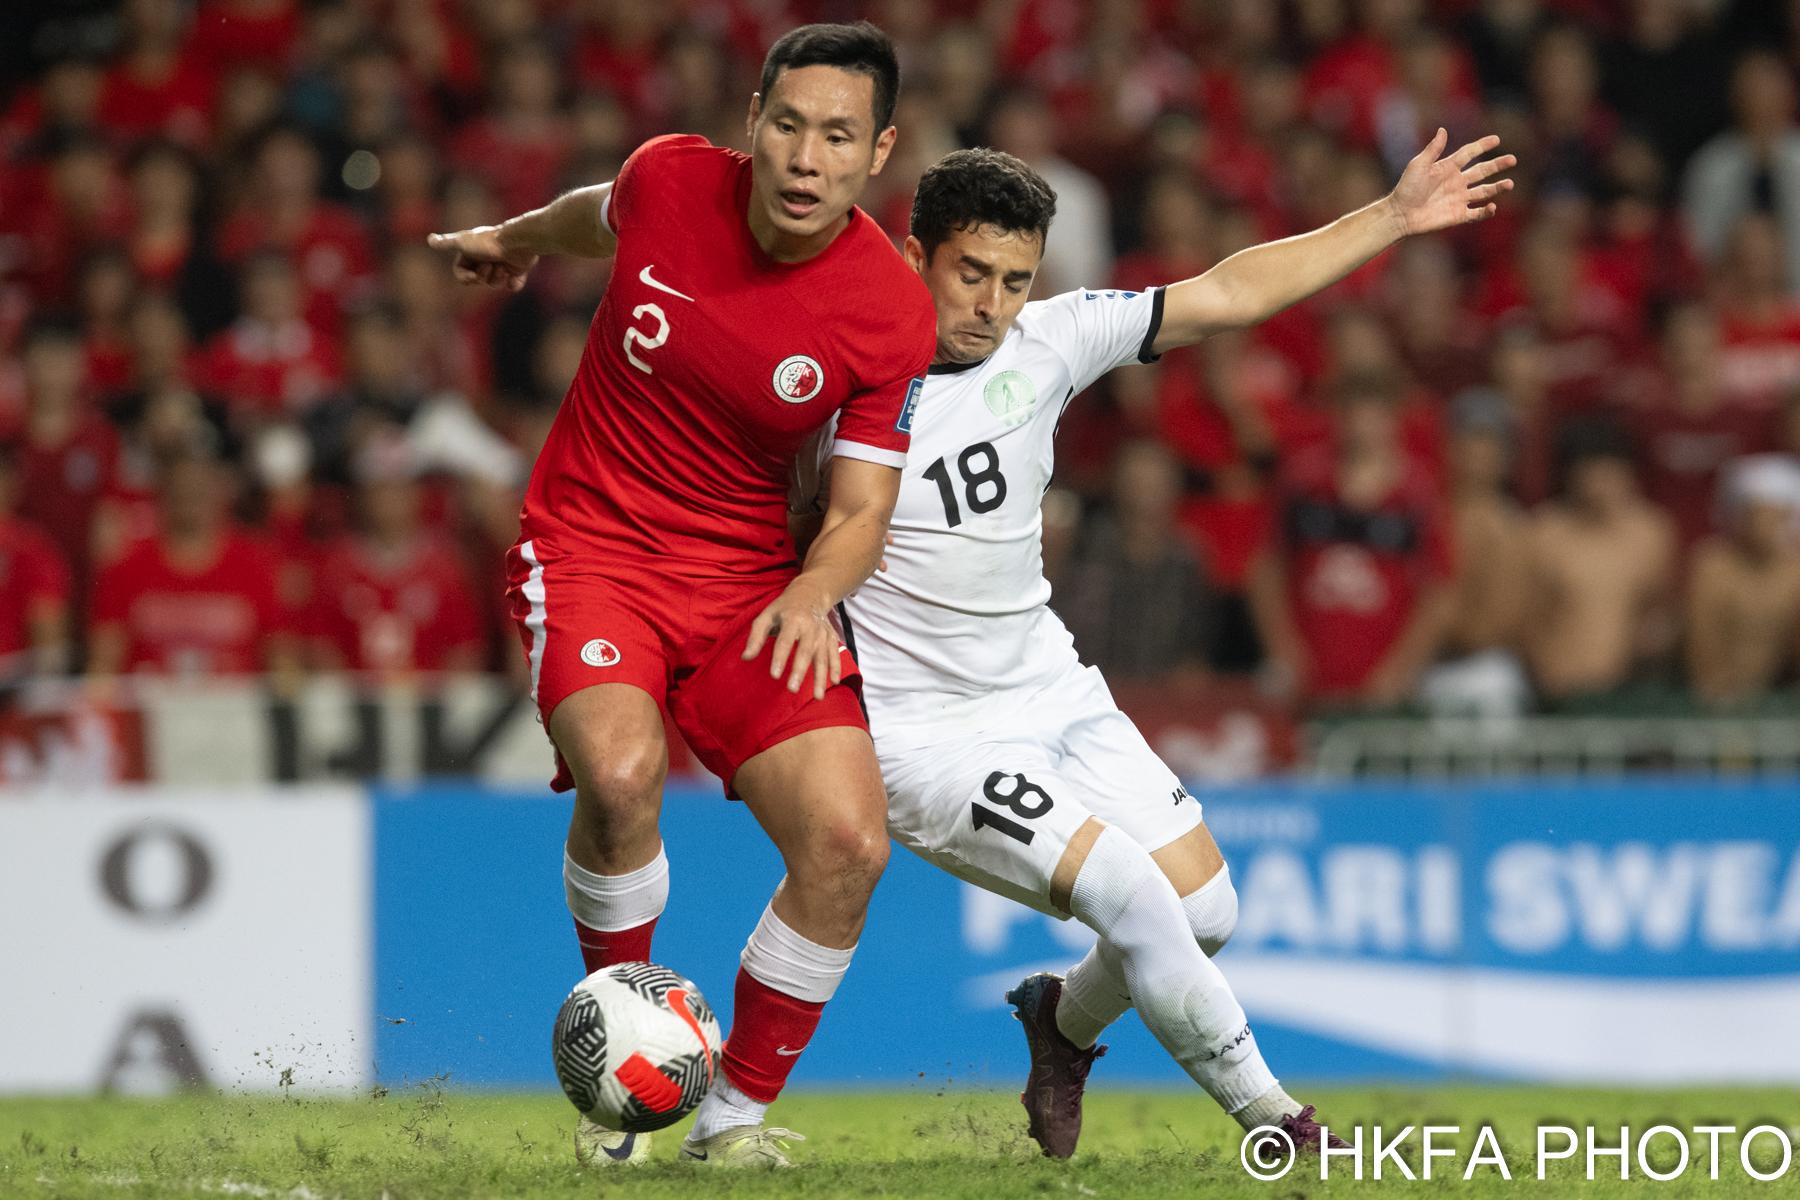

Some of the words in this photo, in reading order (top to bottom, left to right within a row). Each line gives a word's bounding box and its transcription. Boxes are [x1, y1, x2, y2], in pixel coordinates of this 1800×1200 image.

[623, 303, 670, 375] 2
[921, 441, 1007, 528] 18
[971, 770, 1054, 846] 18
[1171, 785, 1187, 805] JA
